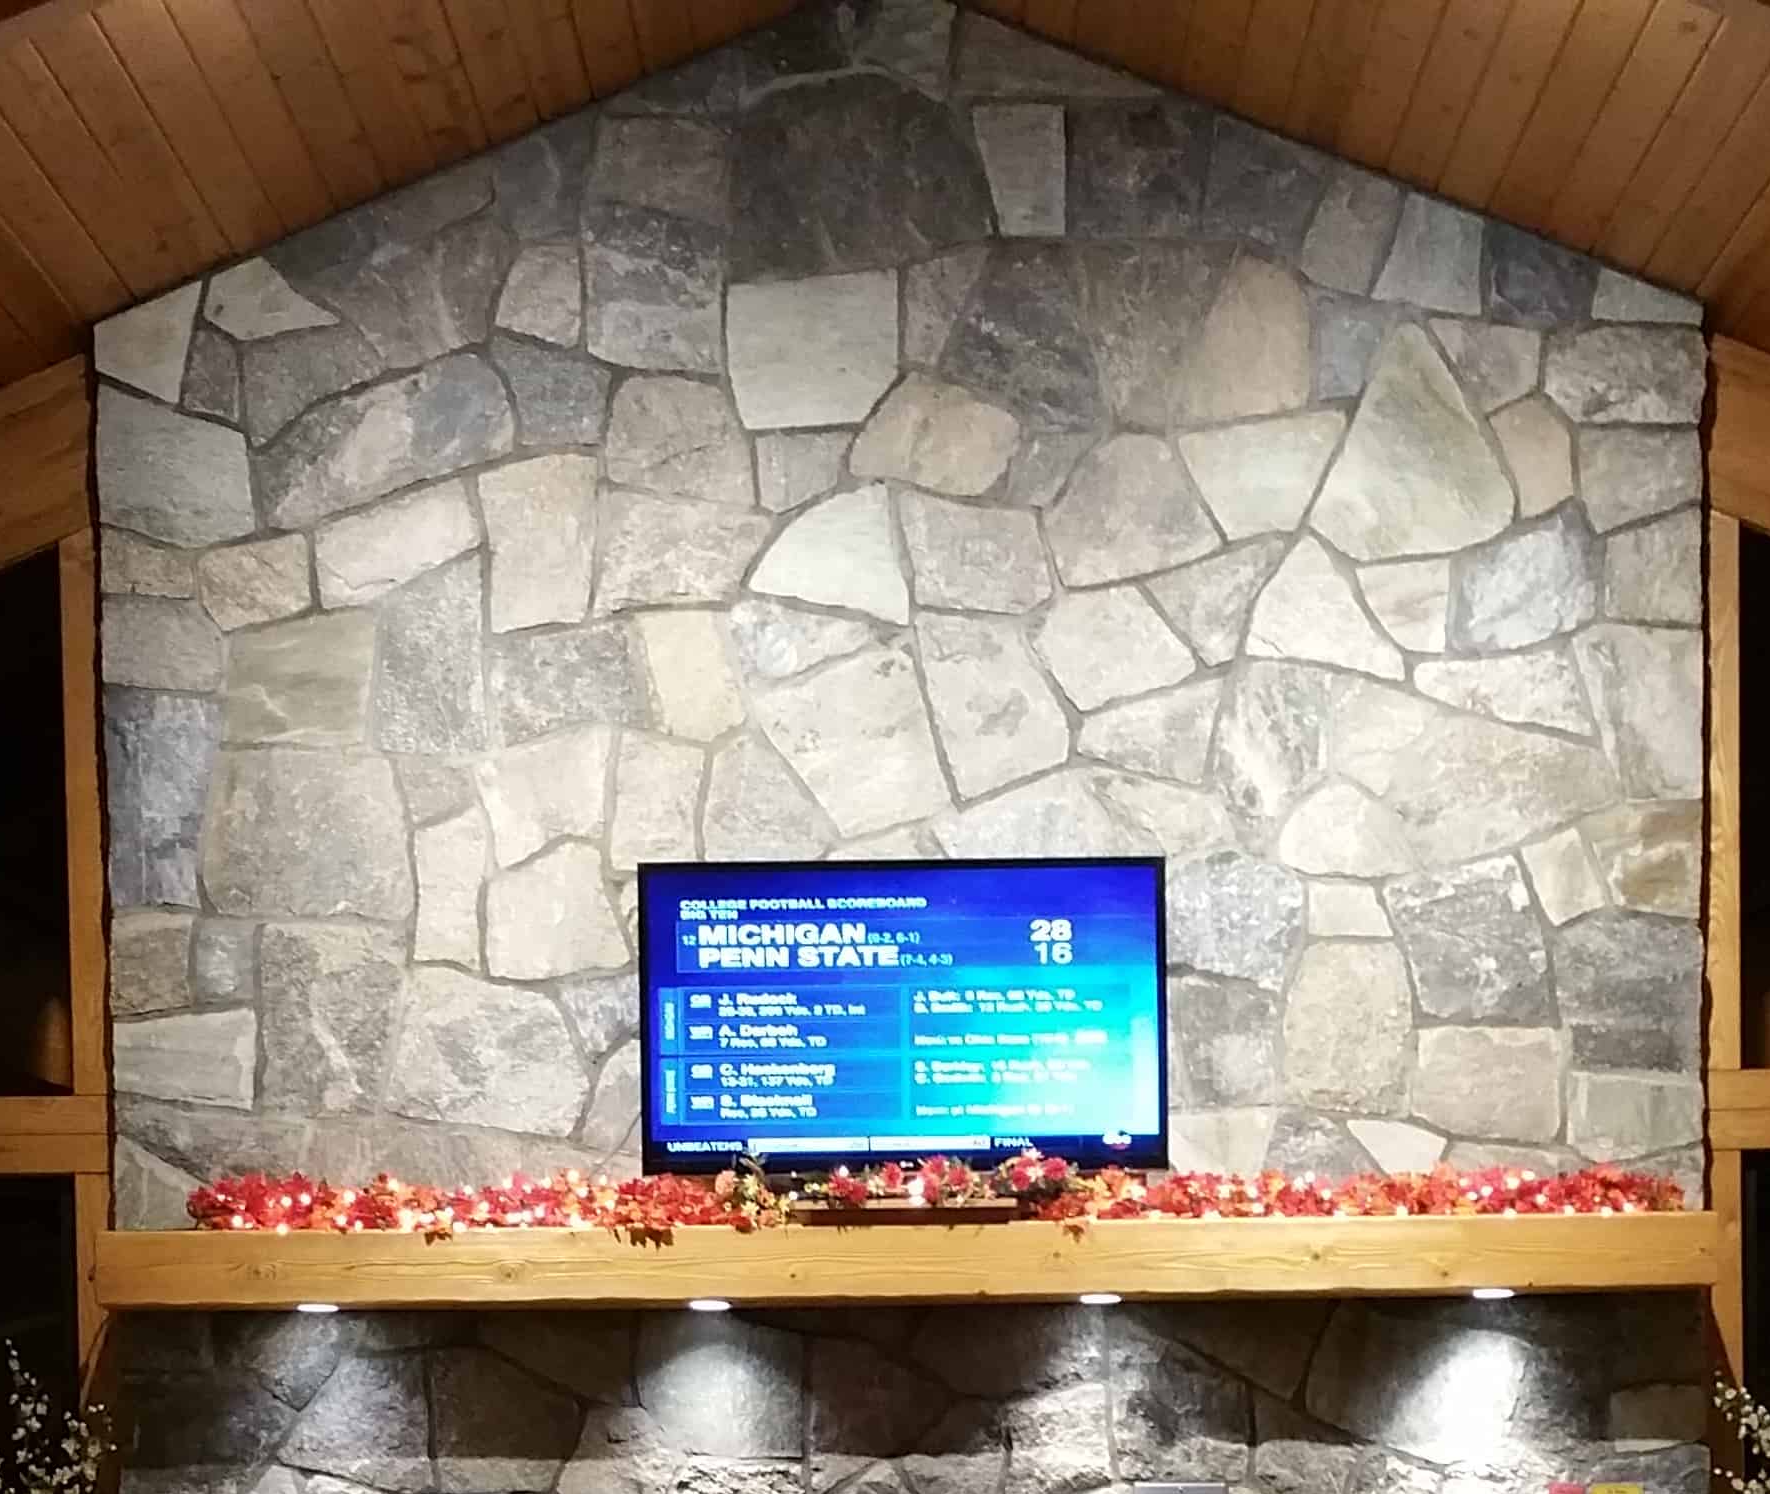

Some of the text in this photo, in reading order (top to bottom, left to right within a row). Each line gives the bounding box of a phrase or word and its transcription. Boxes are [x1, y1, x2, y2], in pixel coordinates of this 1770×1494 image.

[698, 924, 866, 945] MICHIGAN
[1030, 919, 1072, 941] 28
[698, 947, 790, 968] PENN
[797, 945, 899, 967] STATE
[1034, 942, 1073, 965] 16
